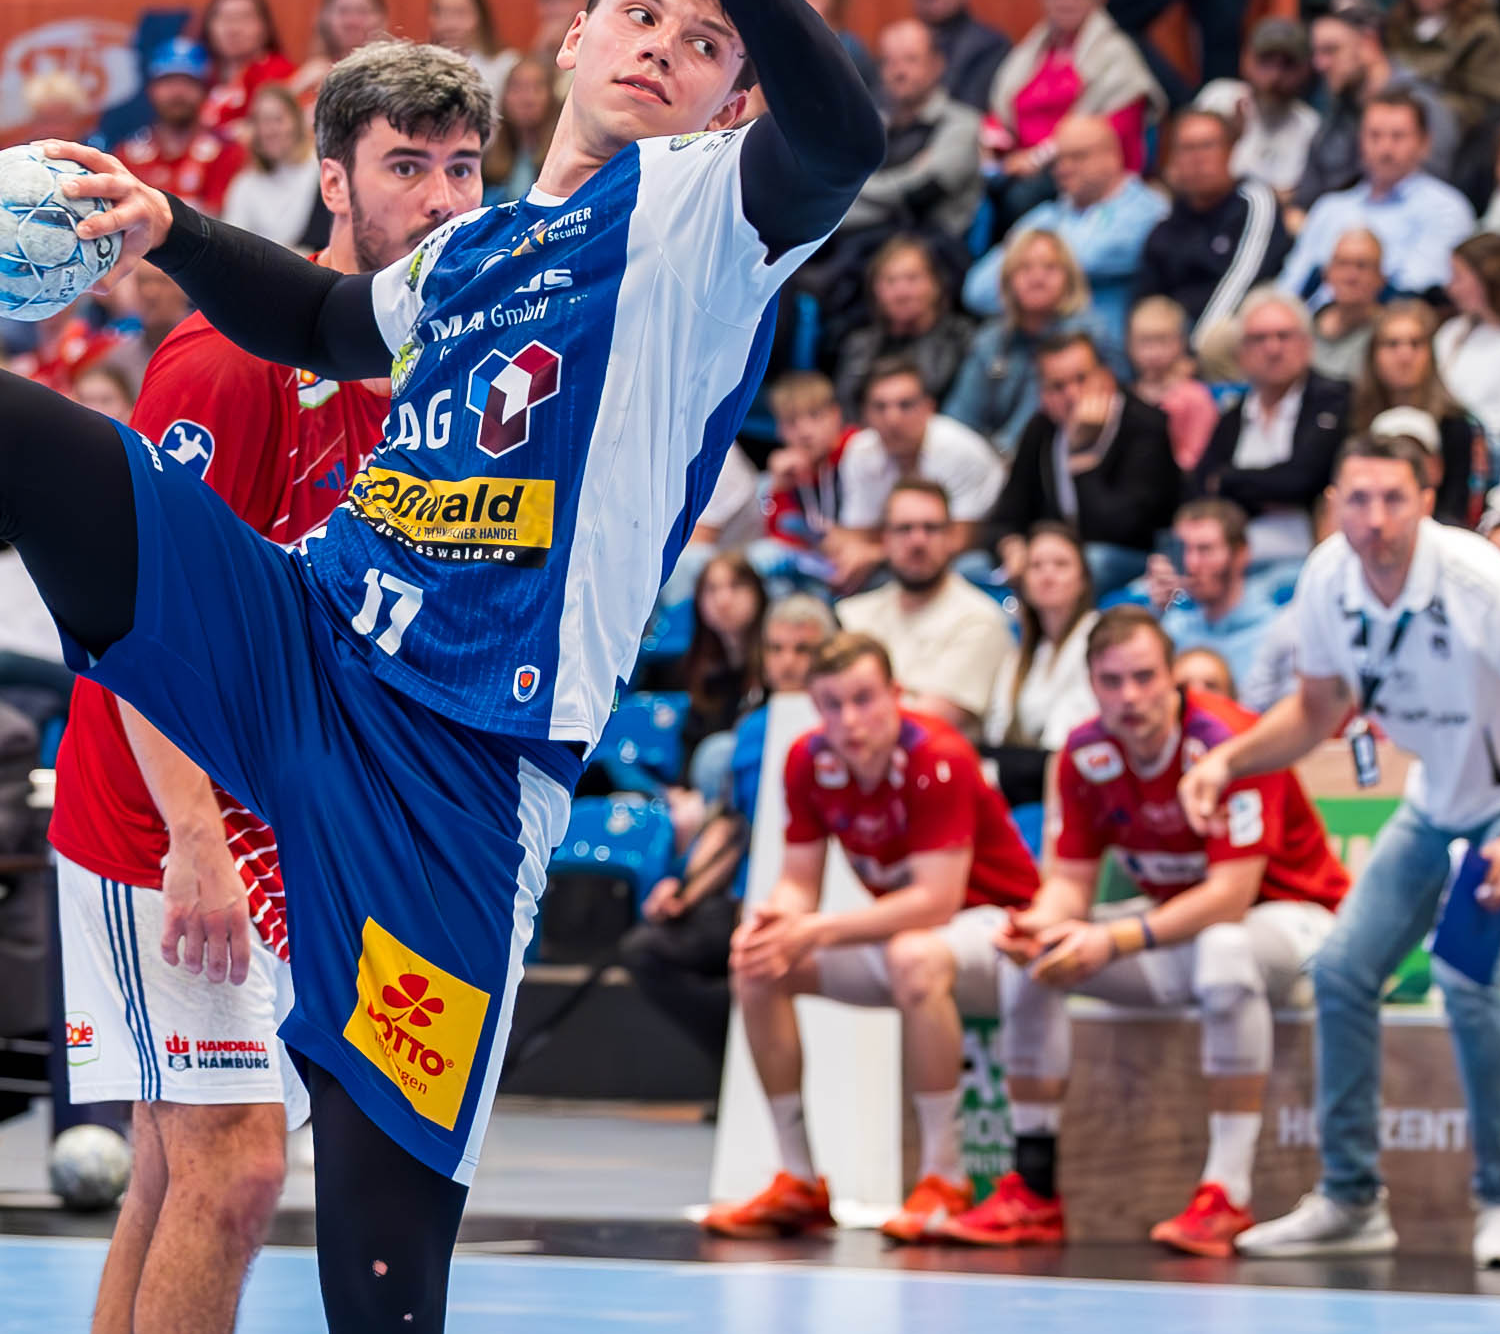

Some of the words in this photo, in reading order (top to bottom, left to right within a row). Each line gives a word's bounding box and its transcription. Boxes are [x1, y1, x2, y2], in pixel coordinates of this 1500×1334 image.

[547, 224, 587, 242] Security
[491, 296, 550, 328] GmbH
[479, 527, 519, 541] HANDEL
[351, 567, 424, 657] 17
[196, 1040, 267, 1052] HANDBALL
[198, 1057, 269, 1069] HAMBURG
